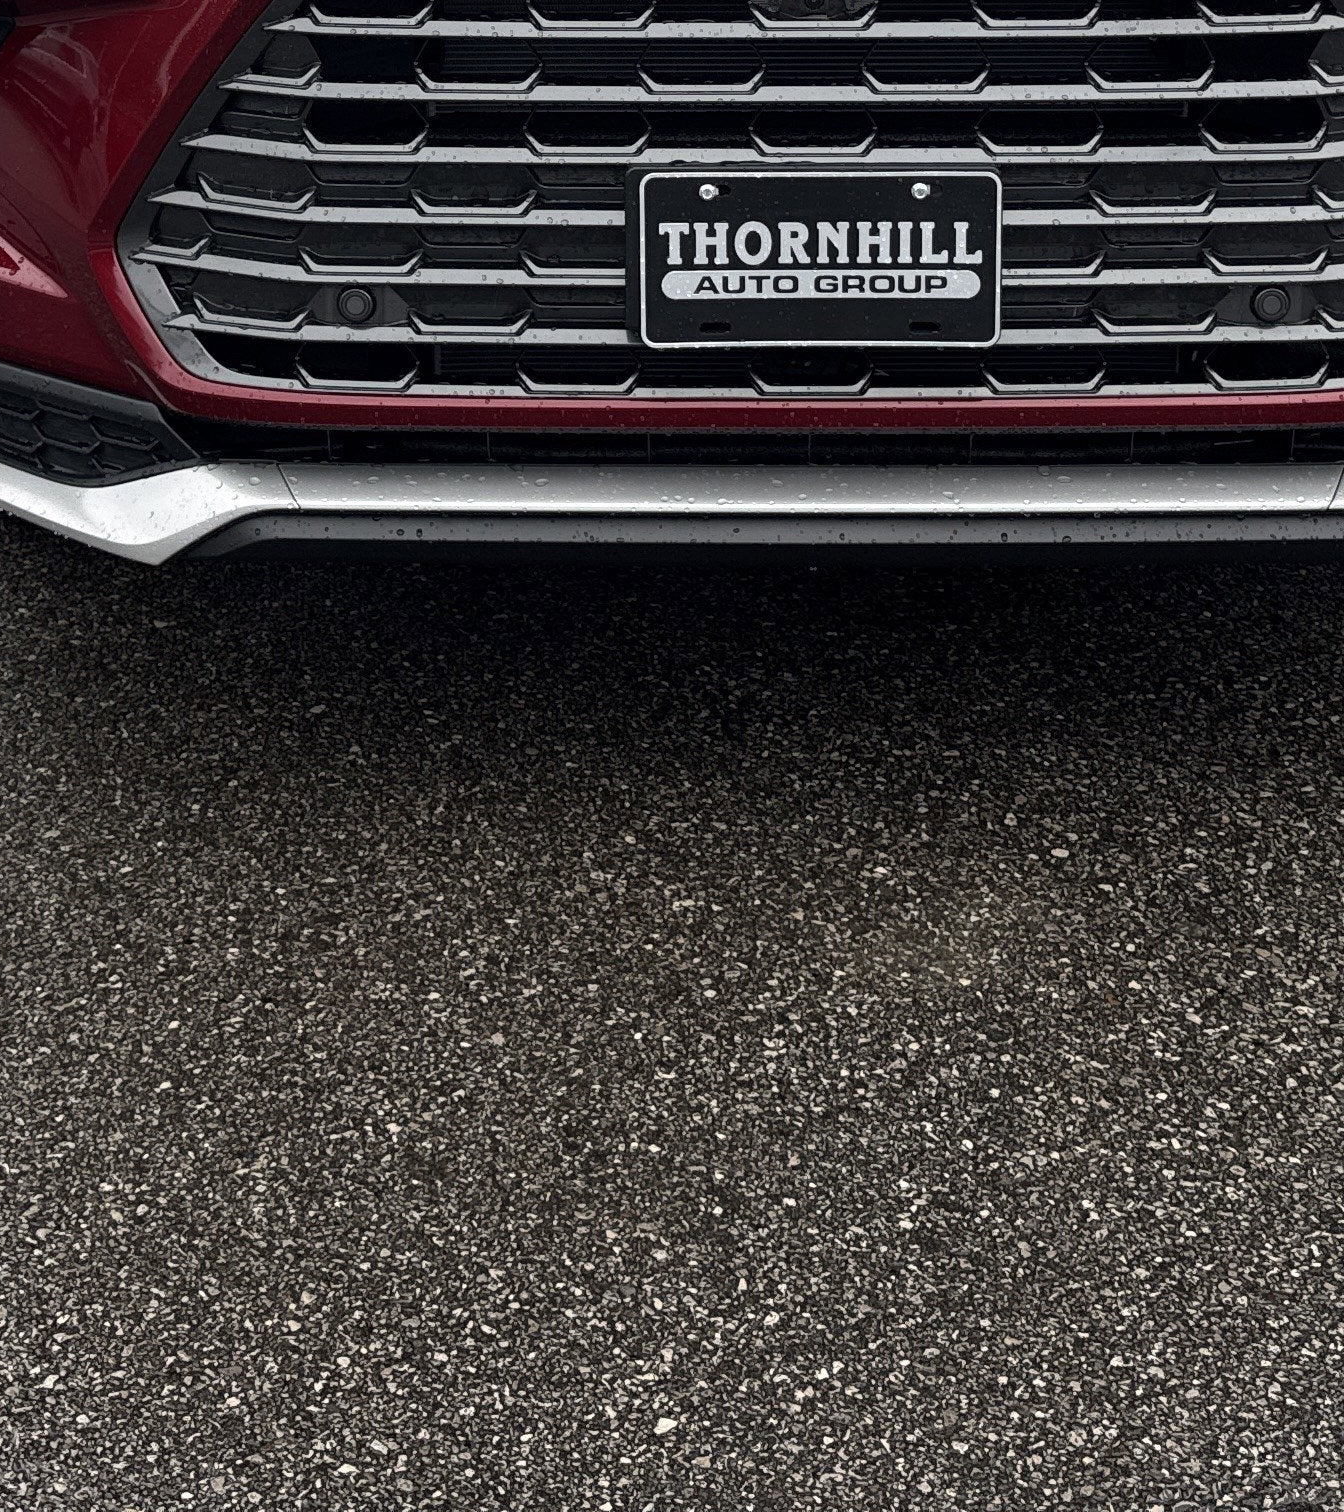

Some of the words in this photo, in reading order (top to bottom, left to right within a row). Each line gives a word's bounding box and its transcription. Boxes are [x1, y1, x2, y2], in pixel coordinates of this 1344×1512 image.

[658, 221, 983, 266] THORNHILL
[693, 275, 800, 295] AUTO
[813, 274, 949, 295] GROUP
